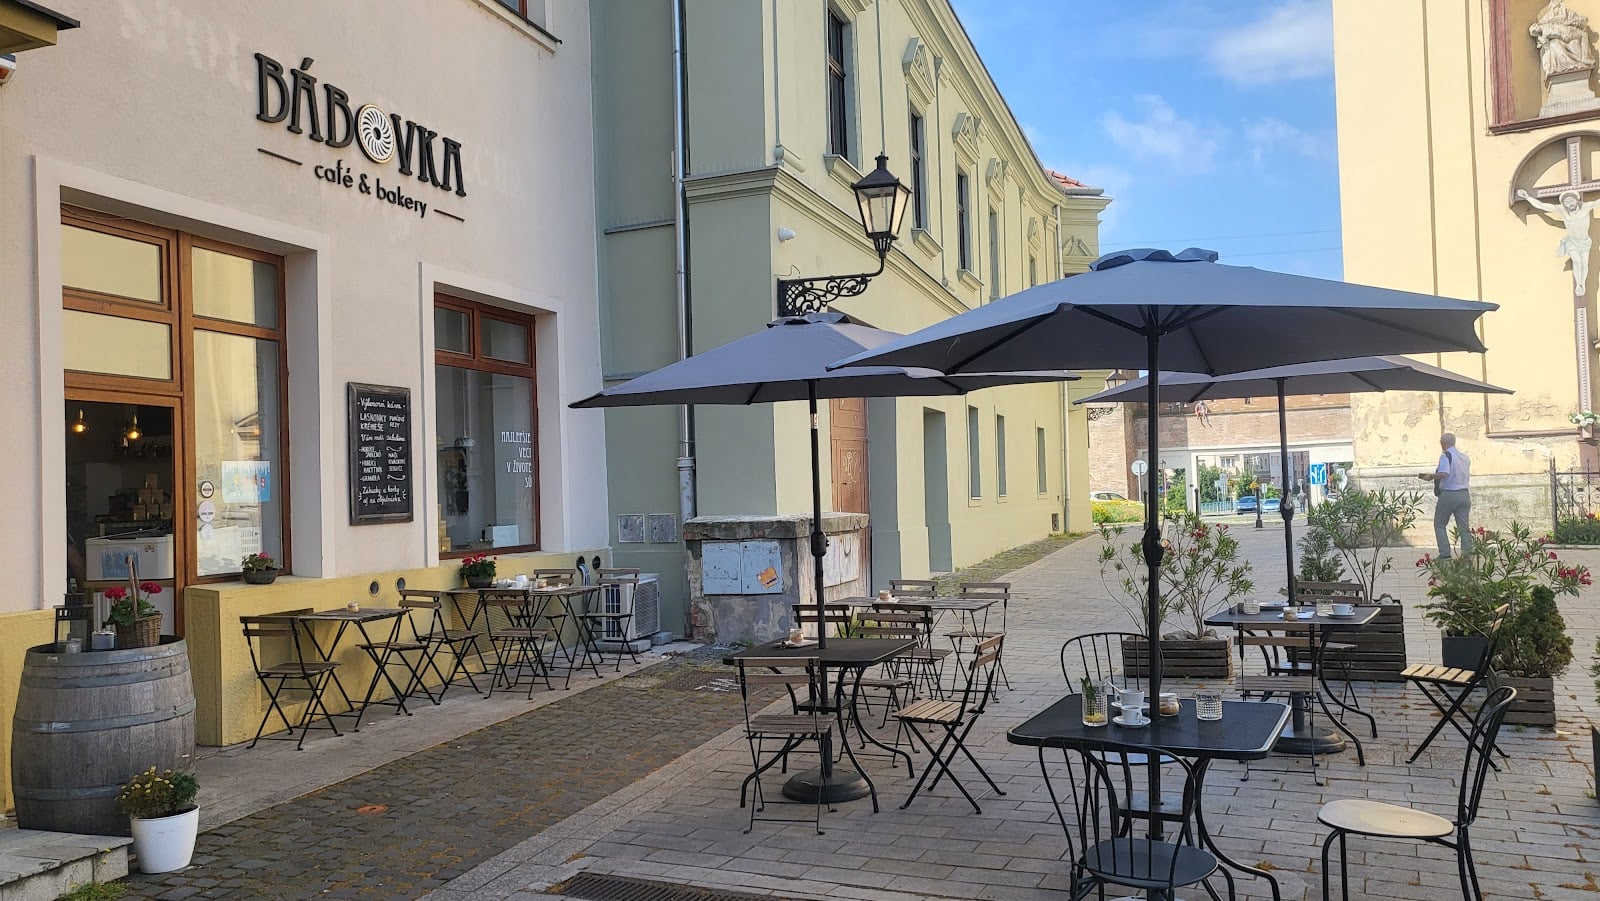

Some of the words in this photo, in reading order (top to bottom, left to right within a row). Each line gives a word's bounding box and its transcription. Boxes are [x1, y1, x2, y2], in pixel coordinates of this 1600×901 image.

[254, 52, 467, 197] BÁBOVKA
[314, 159, 354, 188] café
[359, 173, 371, 195] &
[376, 177, 427, 218] bakery
[501, 431, 531, 443] NAJLEPŠIE
[519, 447, 531, 458] VECI
[506, 462, 511, 472] V
[513, 460, 532, 473] ŽIVOTE
